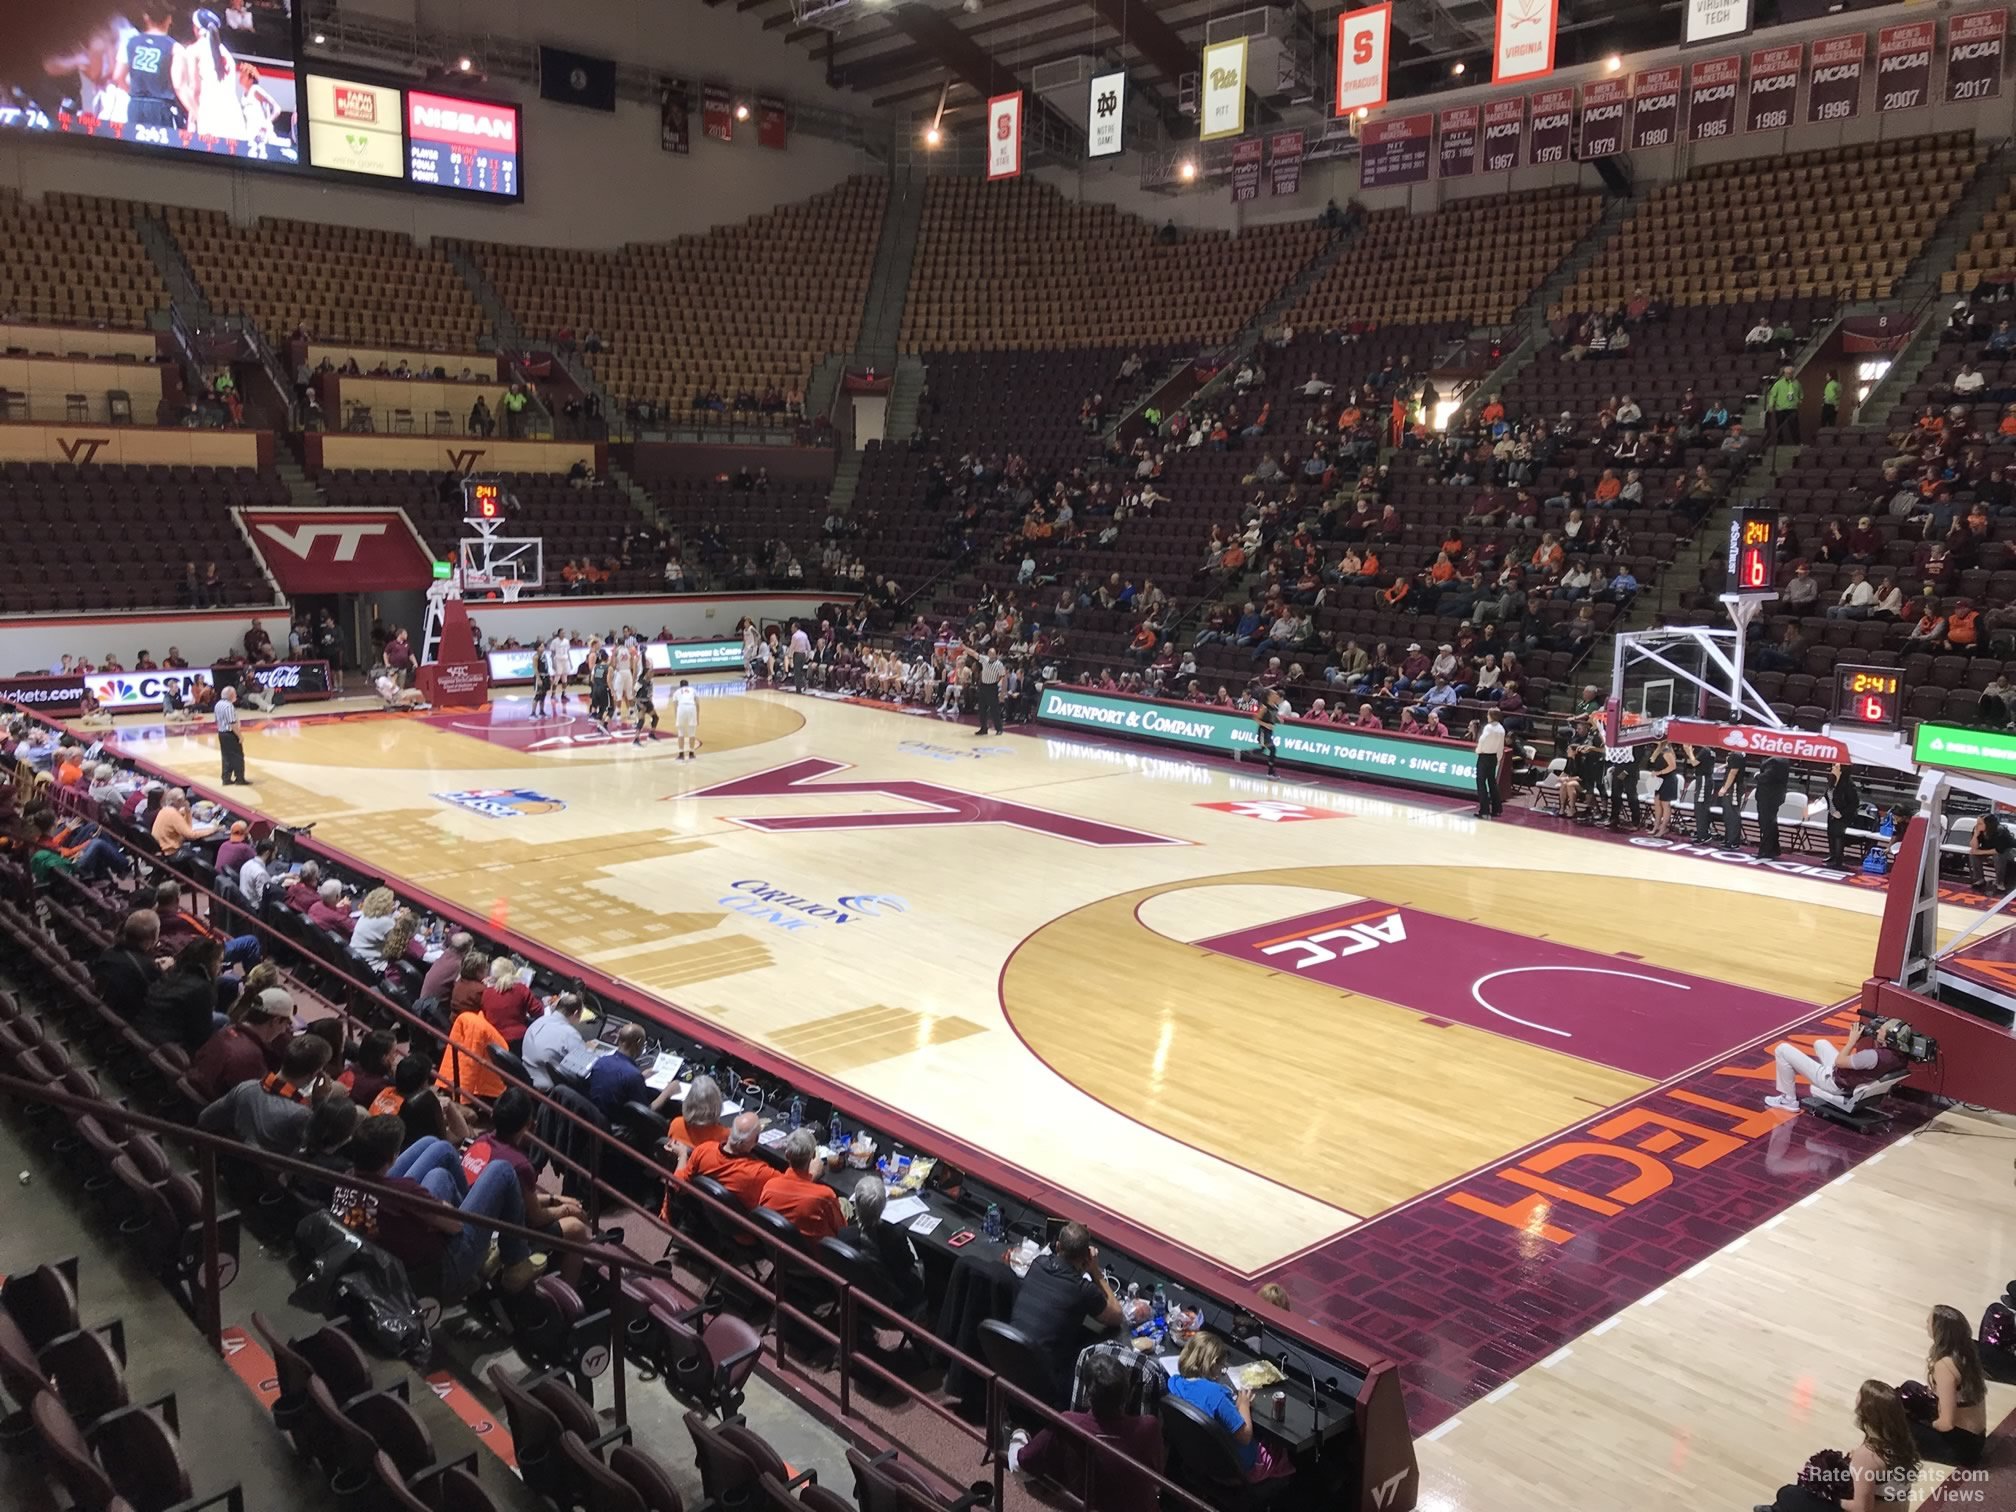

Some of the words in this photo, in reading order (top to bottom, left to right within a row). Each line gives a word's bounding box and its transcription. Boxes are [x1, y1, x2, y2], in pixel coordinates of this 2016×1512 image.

[1697, 0, 1740, 12] VIRGIN
[1705, 9, 1730, 25] TECH
[1353, 30, 1373, 64] S
[1505, 41, 1543, 58] VIRGINIA
[1951, 40, 2000, 61] NCAA
[133, 47, 161, 73] 22
[1880, 52, 1929, 73] NCAA
[1813, 63, 1860, 84] NCAA
[1693, 84, 1735, 104] NCAA
[1752, 74, 1796, 94] NCAA
[1954, 78, 1991, 99] 2017
[1637, 94, 1676, 113] NCAA
[1884, 89, 1919, 110] 2007
[1585, 104, 1623, 123] NCAA
[1755, 110, 1787, 129] 1986
[1817, 100, 1850, 120] 1996
[413, 105, 512, 140] NISSAN
[1487, 122, 1520, 139] NCAA
[1533, 114, 1569, 131] NCAA
[1697, 120, 1727, 138] 1985
[1589, 138, 1616, 155] 1979
[1640, 128, 1667, 147] 1980
[1879, 316, 1888, 327] 8
[57, 438, 109, 464] VT
[447, 450, 485, 473] VT
[1746, 521, 1769, 544] 2:41
[255, 524, 387, 562] VT
[1854, 674, 1897, 694] 2:41
[0, 689, 83, 703] ickets.com
[1047, 695, 1126, 724] DAVENPORT
[1125, 713, 1139, 727] &
[1142, 710, 1214, 739] COMPANY
[1231, 729, 1280, 747] BUILG
[1284, 737, 1330, 755] WEALTH
[1333, 745, 1396, 765] TOGETHER
[1409, 757, 1447, 773] SINCE
[731, 879, 861, 924] CARILION
[1261, 913, 1407, 970] ACC
[1371, 1465, 1410, 1510] VT
